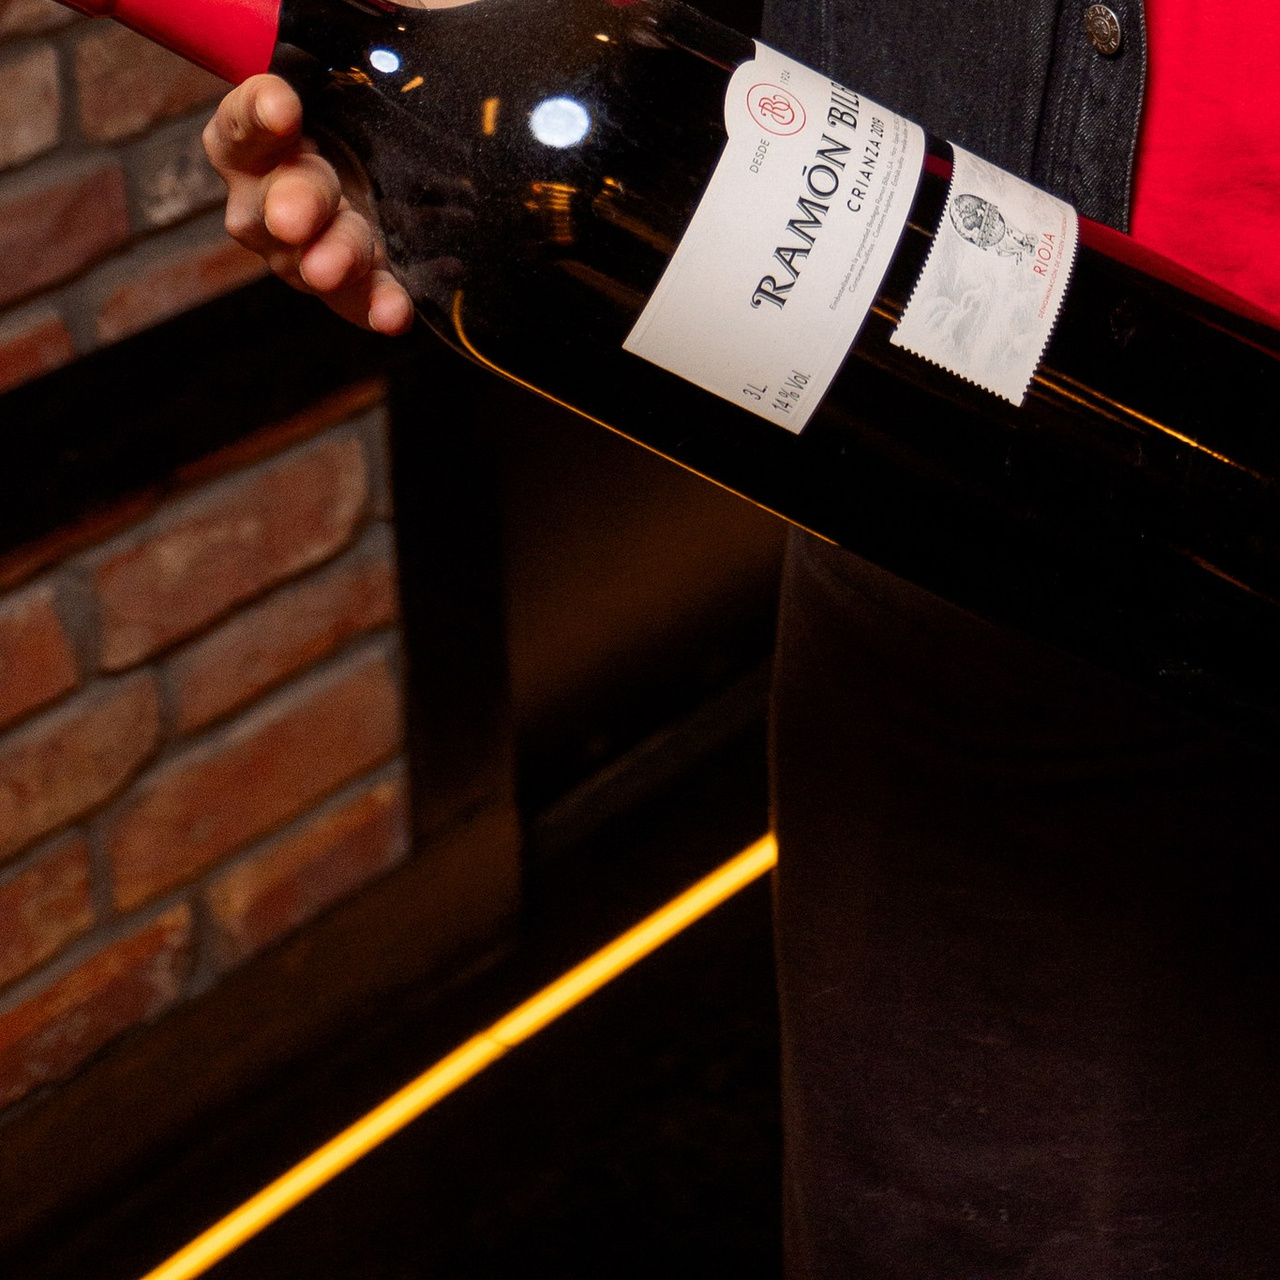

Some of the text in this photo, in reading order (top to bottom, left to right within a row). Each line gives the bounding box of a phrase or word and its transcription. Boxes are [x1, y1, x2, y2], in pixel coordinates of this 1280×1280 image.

[749, 138, 770, 173] DESDE
[847, 117, 885, 213] CRIANZA 2019
[1033, 232, 1055, 276] RIOJA
[742, 388, 761, 401] 3
[784, 370, 811, 390] Vol.
